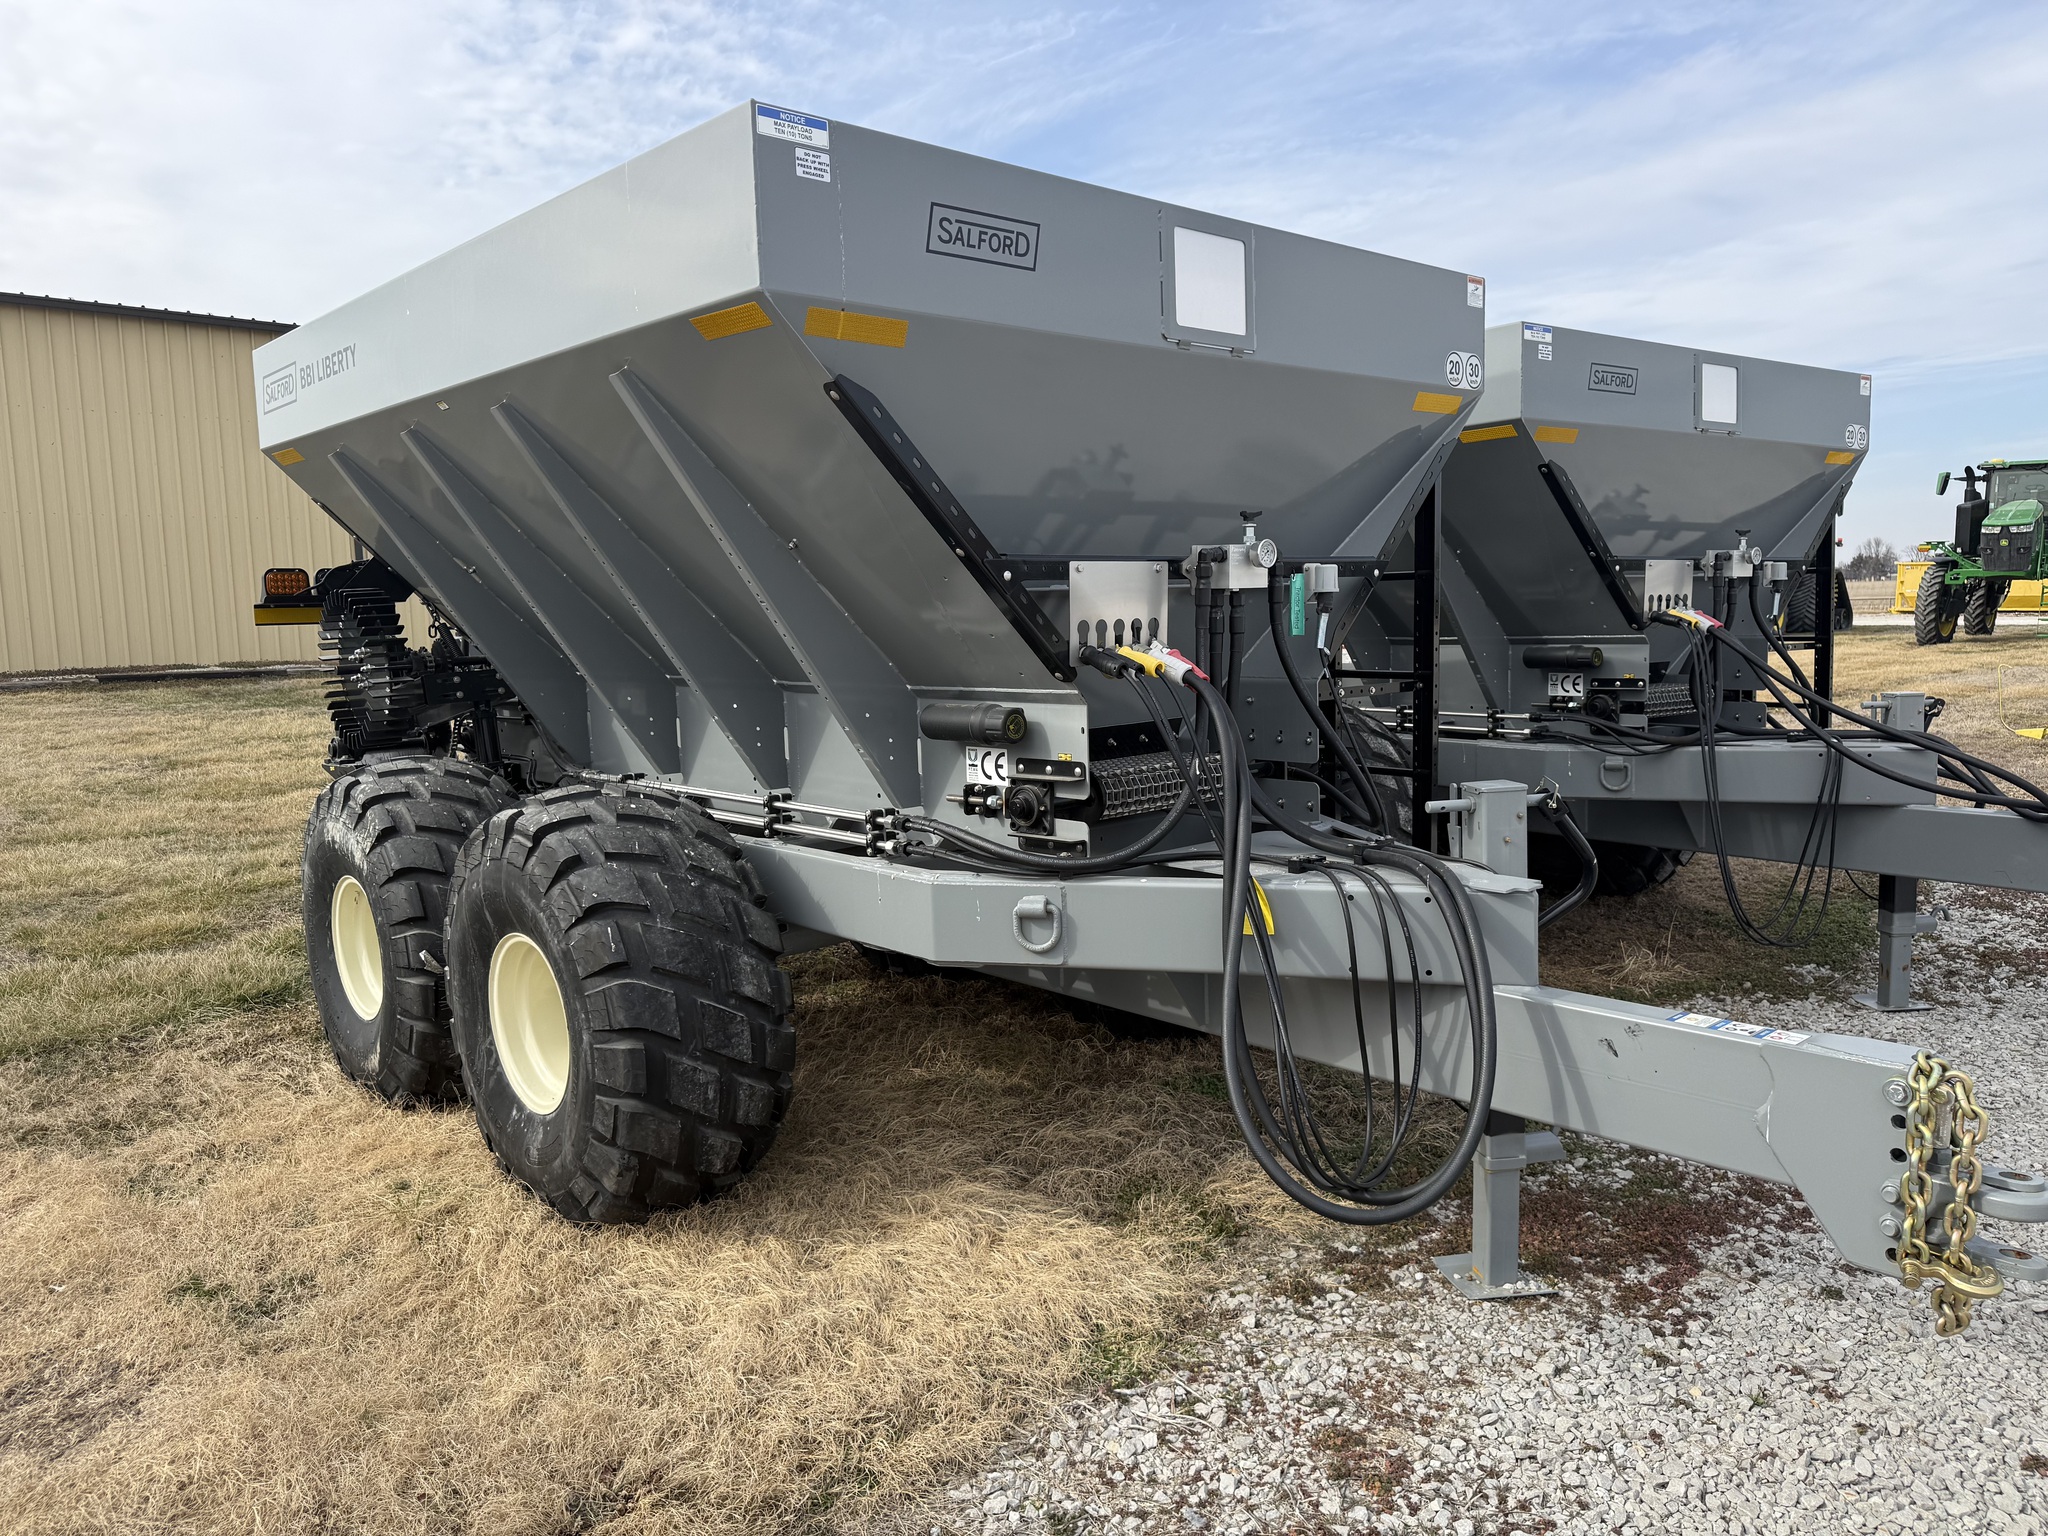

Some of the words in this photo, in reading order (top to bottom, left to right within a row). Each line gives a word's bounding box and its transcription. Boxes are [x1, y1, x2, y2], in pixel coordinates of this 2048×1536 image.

[780, 112, 806, 124] NOTICE
[774, 121, 786, 129] MAX
[787, 123, 813, 134] PAYLOAD
[774, 127, 785, 135] TEN
[787, 130, 797, 139] (10)
[798, 133, 812, 141] TONS
[803, 170, 824, 178] ENGAGED
[937, 216, 1030, 258] SALFORD
[265, 373, 295, 405] SALFORD
[300, 362, 316, 390] BBI
[317, 343, 356, 382] LIBERTY
[1449, 360, 1460, 375] 20
[1469, 363, 1479, 378] 30
[1593, 369, 1634, 388] SALFORD
[1847, 430, 1854, 440] 20
[1859, 431, 1865, 442] 30
[1561, 674, 1582, 694] CE
[981, 750, 1006, 782] CE
